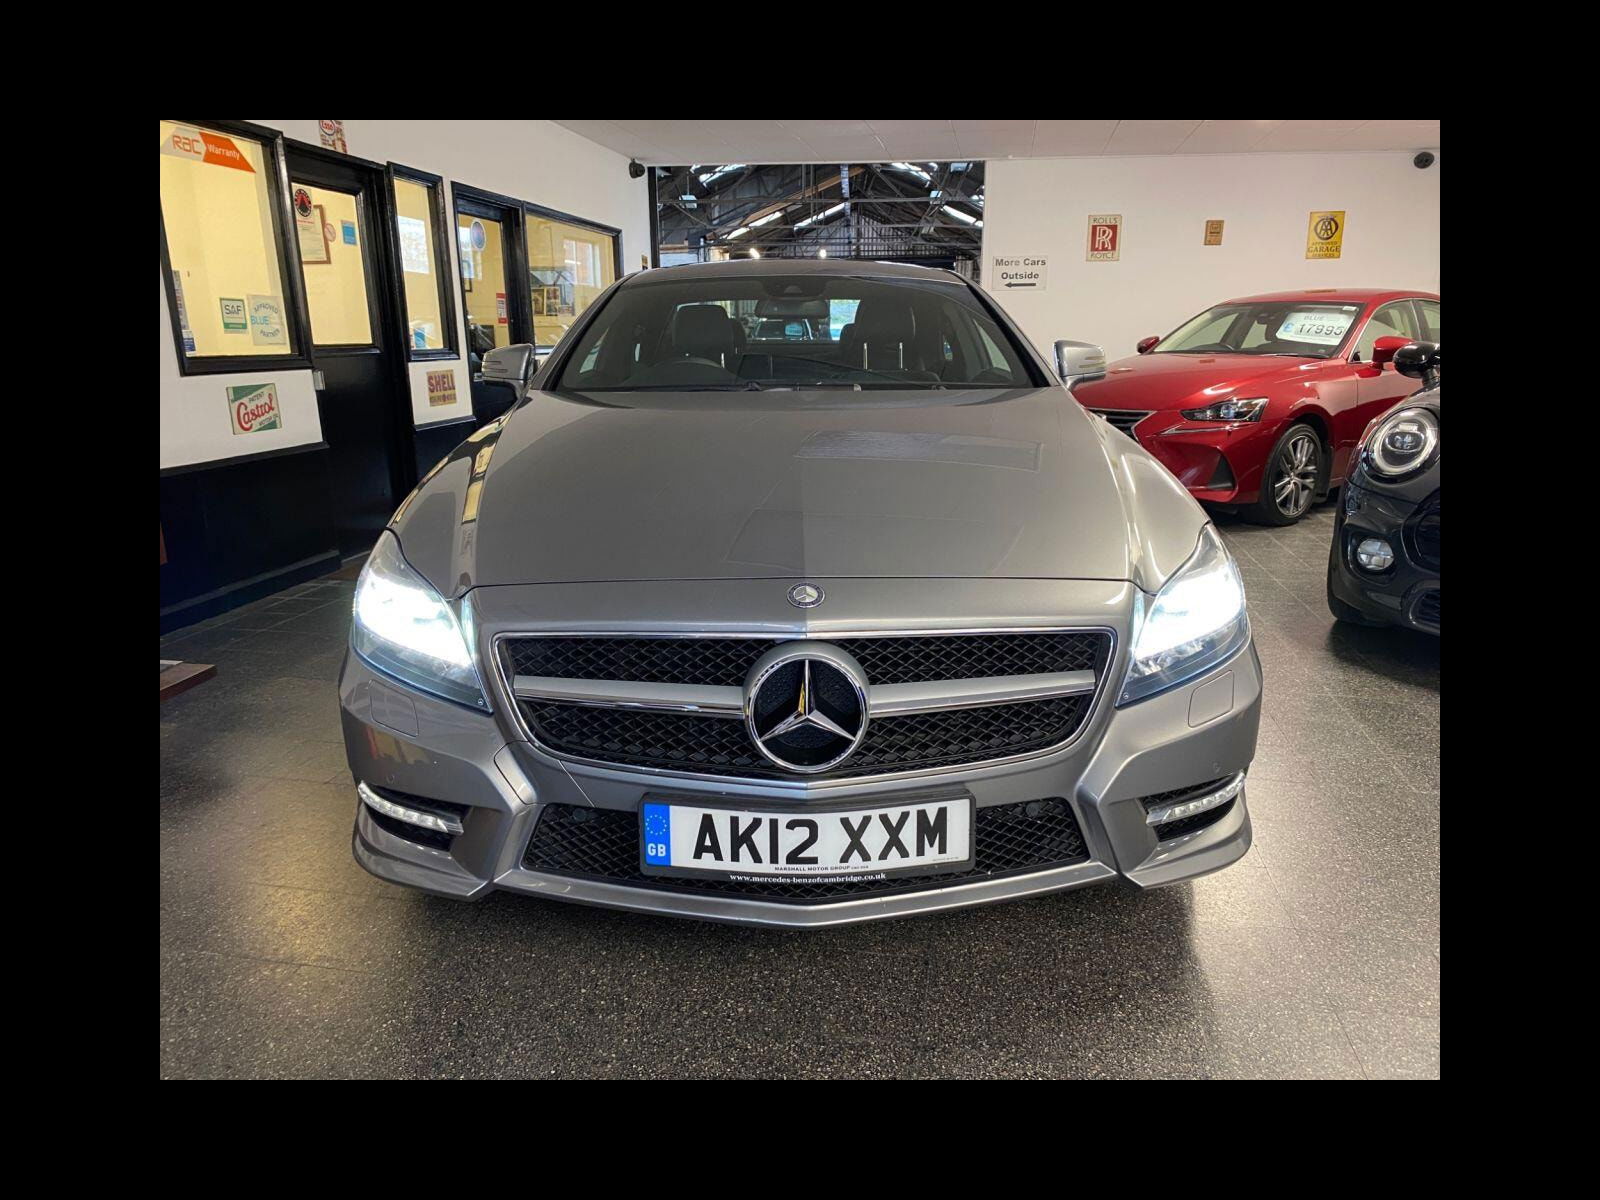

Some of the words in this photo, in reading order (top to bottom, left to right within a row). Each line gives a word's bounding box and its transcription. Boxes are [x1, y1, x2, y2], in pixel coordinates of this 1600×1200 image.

[207, 143, 240, 161] Warranty
[995, 259, 1020, 267] More
[1023, 258, 1046, 266] Cars
[1001, 272, 1039, 280] Outside
[224, 304, 242, 315] SAF
[254, 303, 279, 314] APPROVED
[250, 315, 269, 325] BLUE
[1299, 323, 1345, 336] 17995
[427, 373, 456, 393] SHELL
[236, 393, 274, 431] Castrol
[259, 416, 273, 426] MOTOR
[693, 813, 819, 865] AK12
[839, 807, 948, 864] XXM
[647, 843, 667, 857] GB
[729, 872, 887, 885] www.mercedes-benzofcambridge.co.uk
